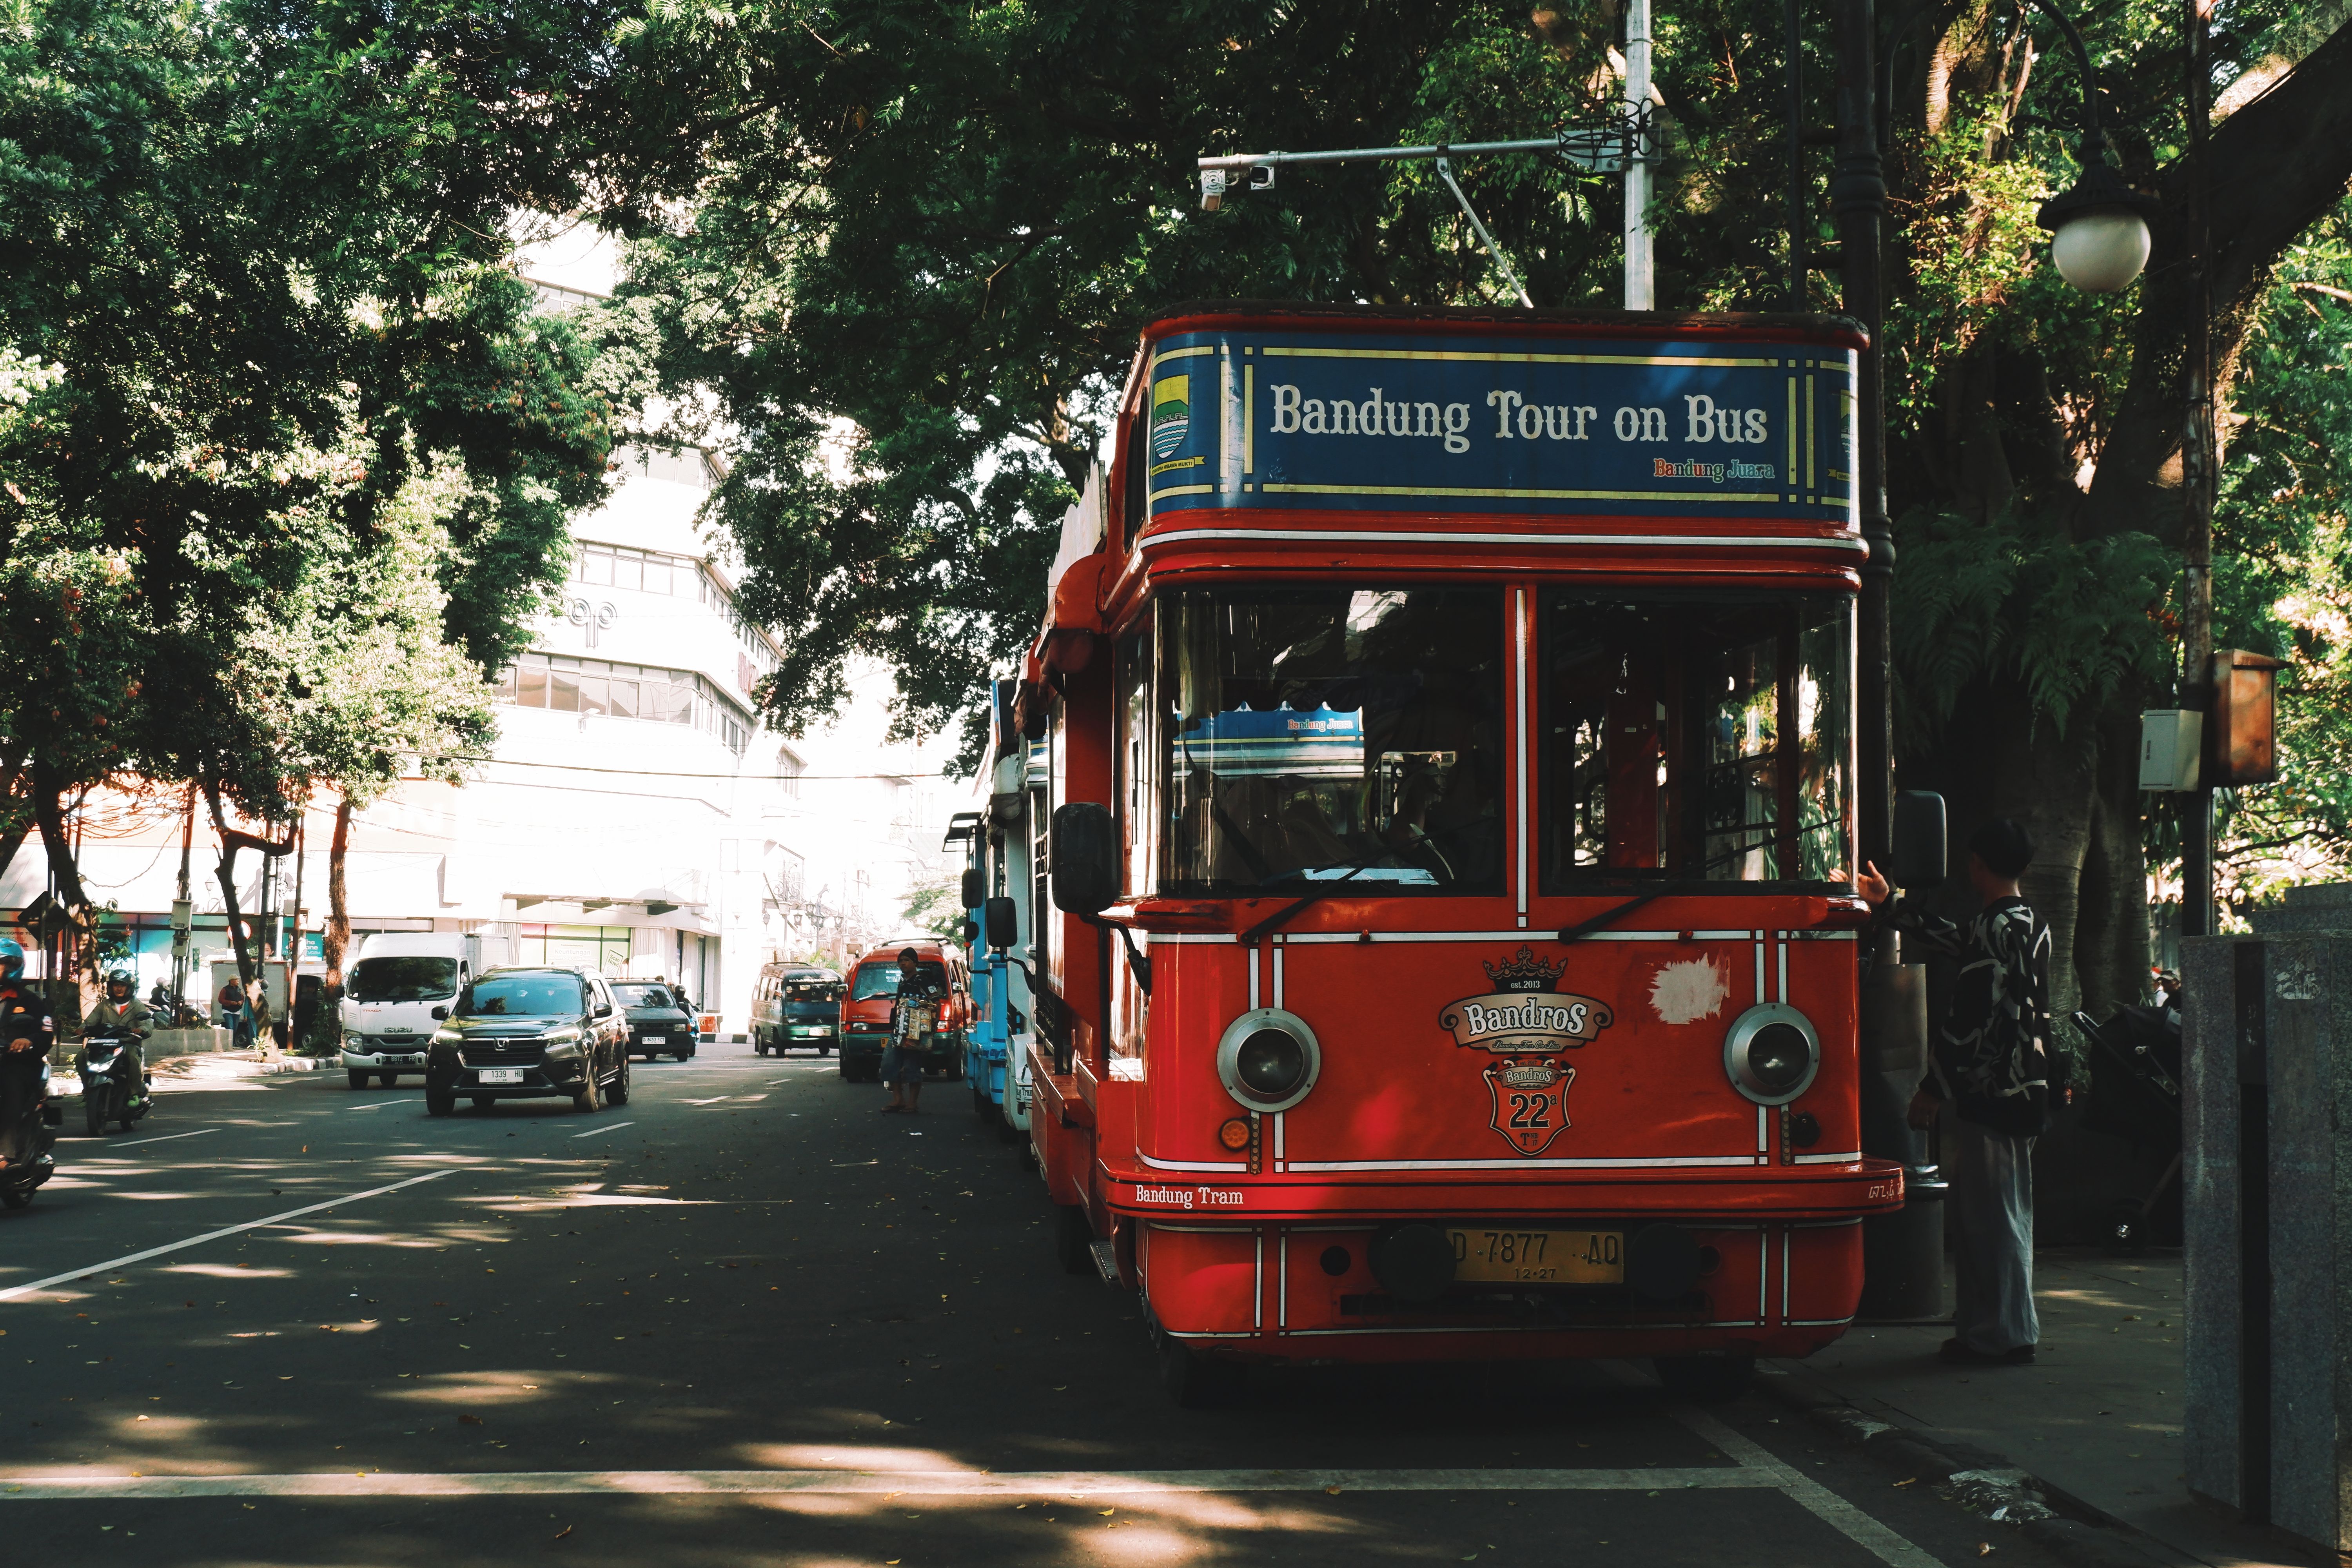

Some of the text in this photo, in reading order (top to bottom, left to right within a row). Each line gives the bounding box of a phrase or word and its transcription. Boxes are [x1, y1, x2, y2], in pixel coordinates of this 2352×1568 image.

[1270, 385, 1767, 454] Bandung Tour on Bus
[1653, 458, 1775, 483] Bandung Juara
[1287, 719, 1353, 732] Bandung Juara
[608, 958, 619, 967] Now!
[610, 954, 620, 963] Scan
[1510, 980, 1540, 989] est.2013
[1492, 1040, 1561, 1051] Bandung Tour On Bus
[1136, 1184, 1244, 1209] Bandung Tram
[1453, 1232, 1466, 1262] D
[1484, 1232, 1548, 1263] 7877
